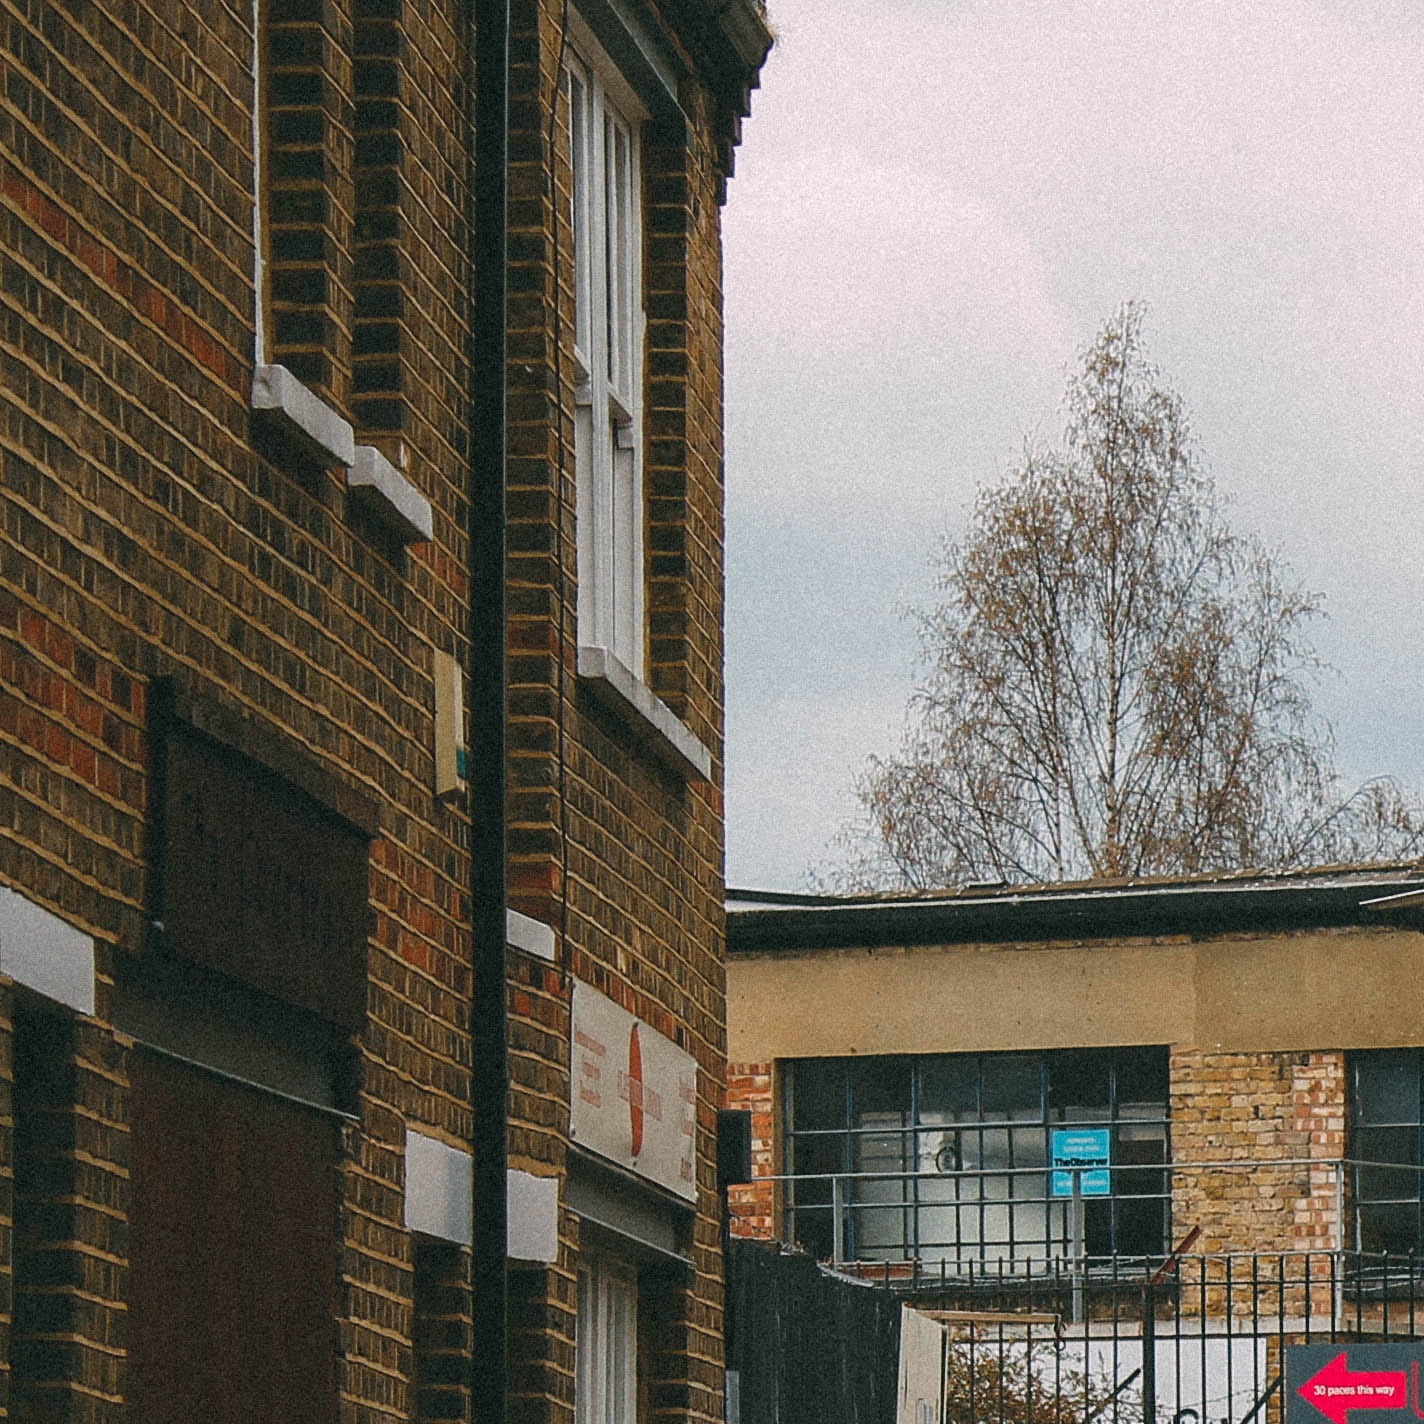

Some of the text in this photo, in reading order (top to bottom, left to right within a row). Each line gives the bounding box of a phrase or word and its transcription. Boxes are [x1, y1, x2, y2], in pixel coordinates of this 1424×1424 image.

[1313, 1384, 1395, 1397] 30 paces this way
